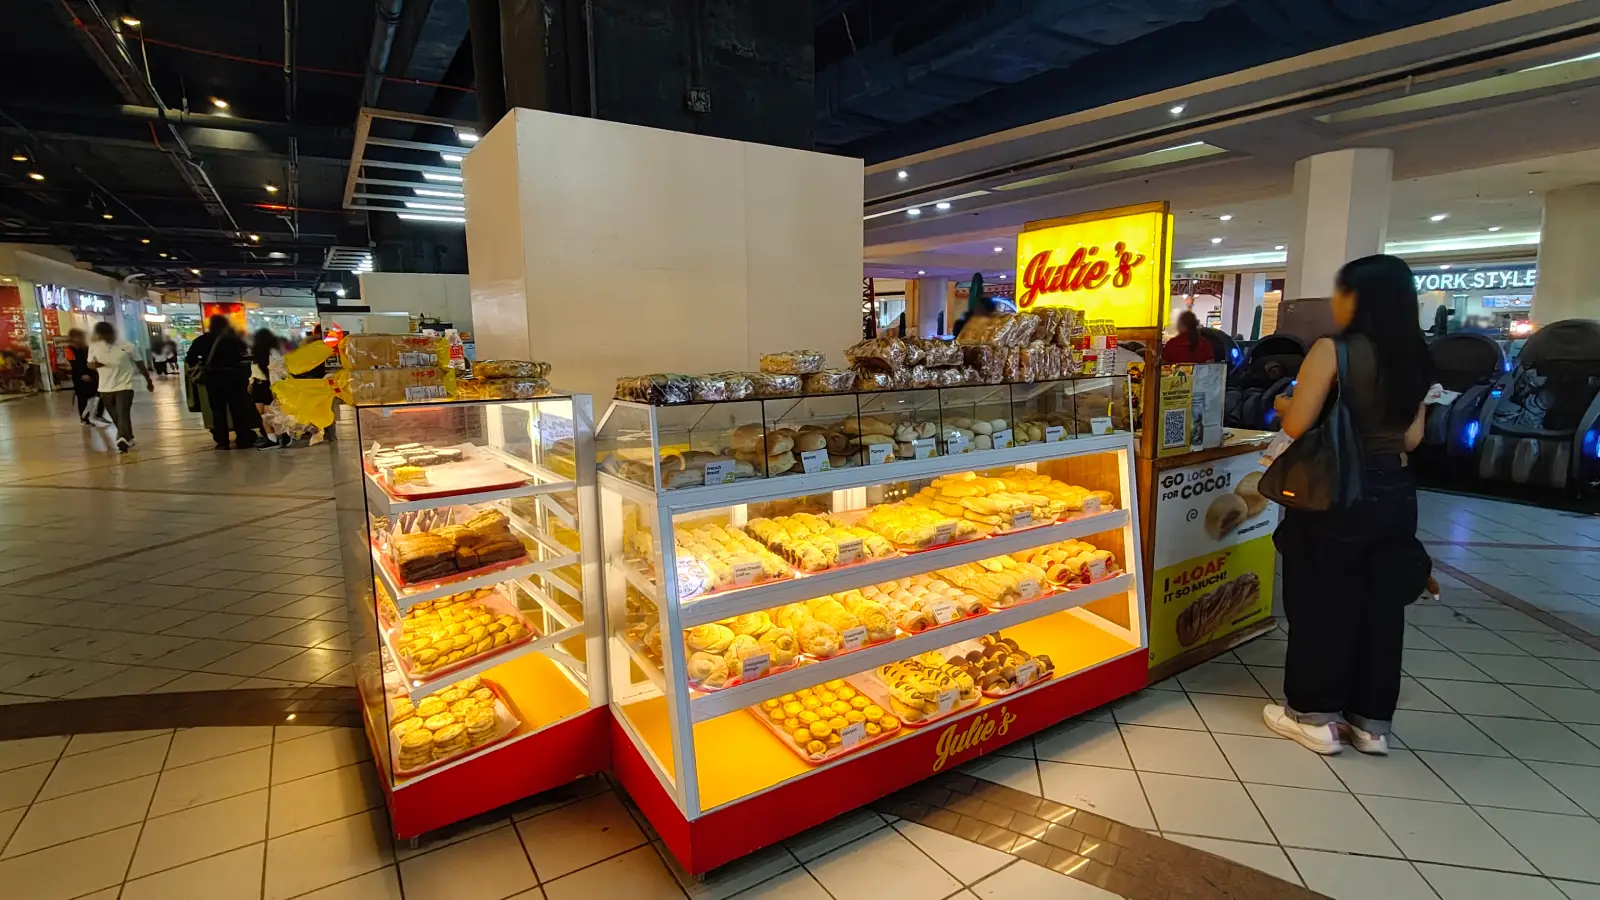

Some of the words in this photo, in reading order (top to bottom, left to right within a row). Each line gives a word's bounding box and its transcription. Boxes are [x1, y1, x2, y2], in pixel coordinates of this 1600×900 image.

[1019, 241, 1145, 308] Julie's
[1415, 272, 1468, 290] YORK
[1472, 269, 1536, 289] STYLE
[1161, 473, 1184, 489] GO
[1187, 468, 1213, 482] LOCO
[1162, 490, 1179, 501] FOR
[1181, 472, 1231, 499] COCO!
[1163, 592, 1174, 604] IT
[1175, 585, 1190, 598] SO
[1191, 570, 1228, 592] MUCH!
[1164, 577, 1170, 592] I
[1182, 556, 1226, 585] LOAF
[932, 706, 1017, 772] Julie's
